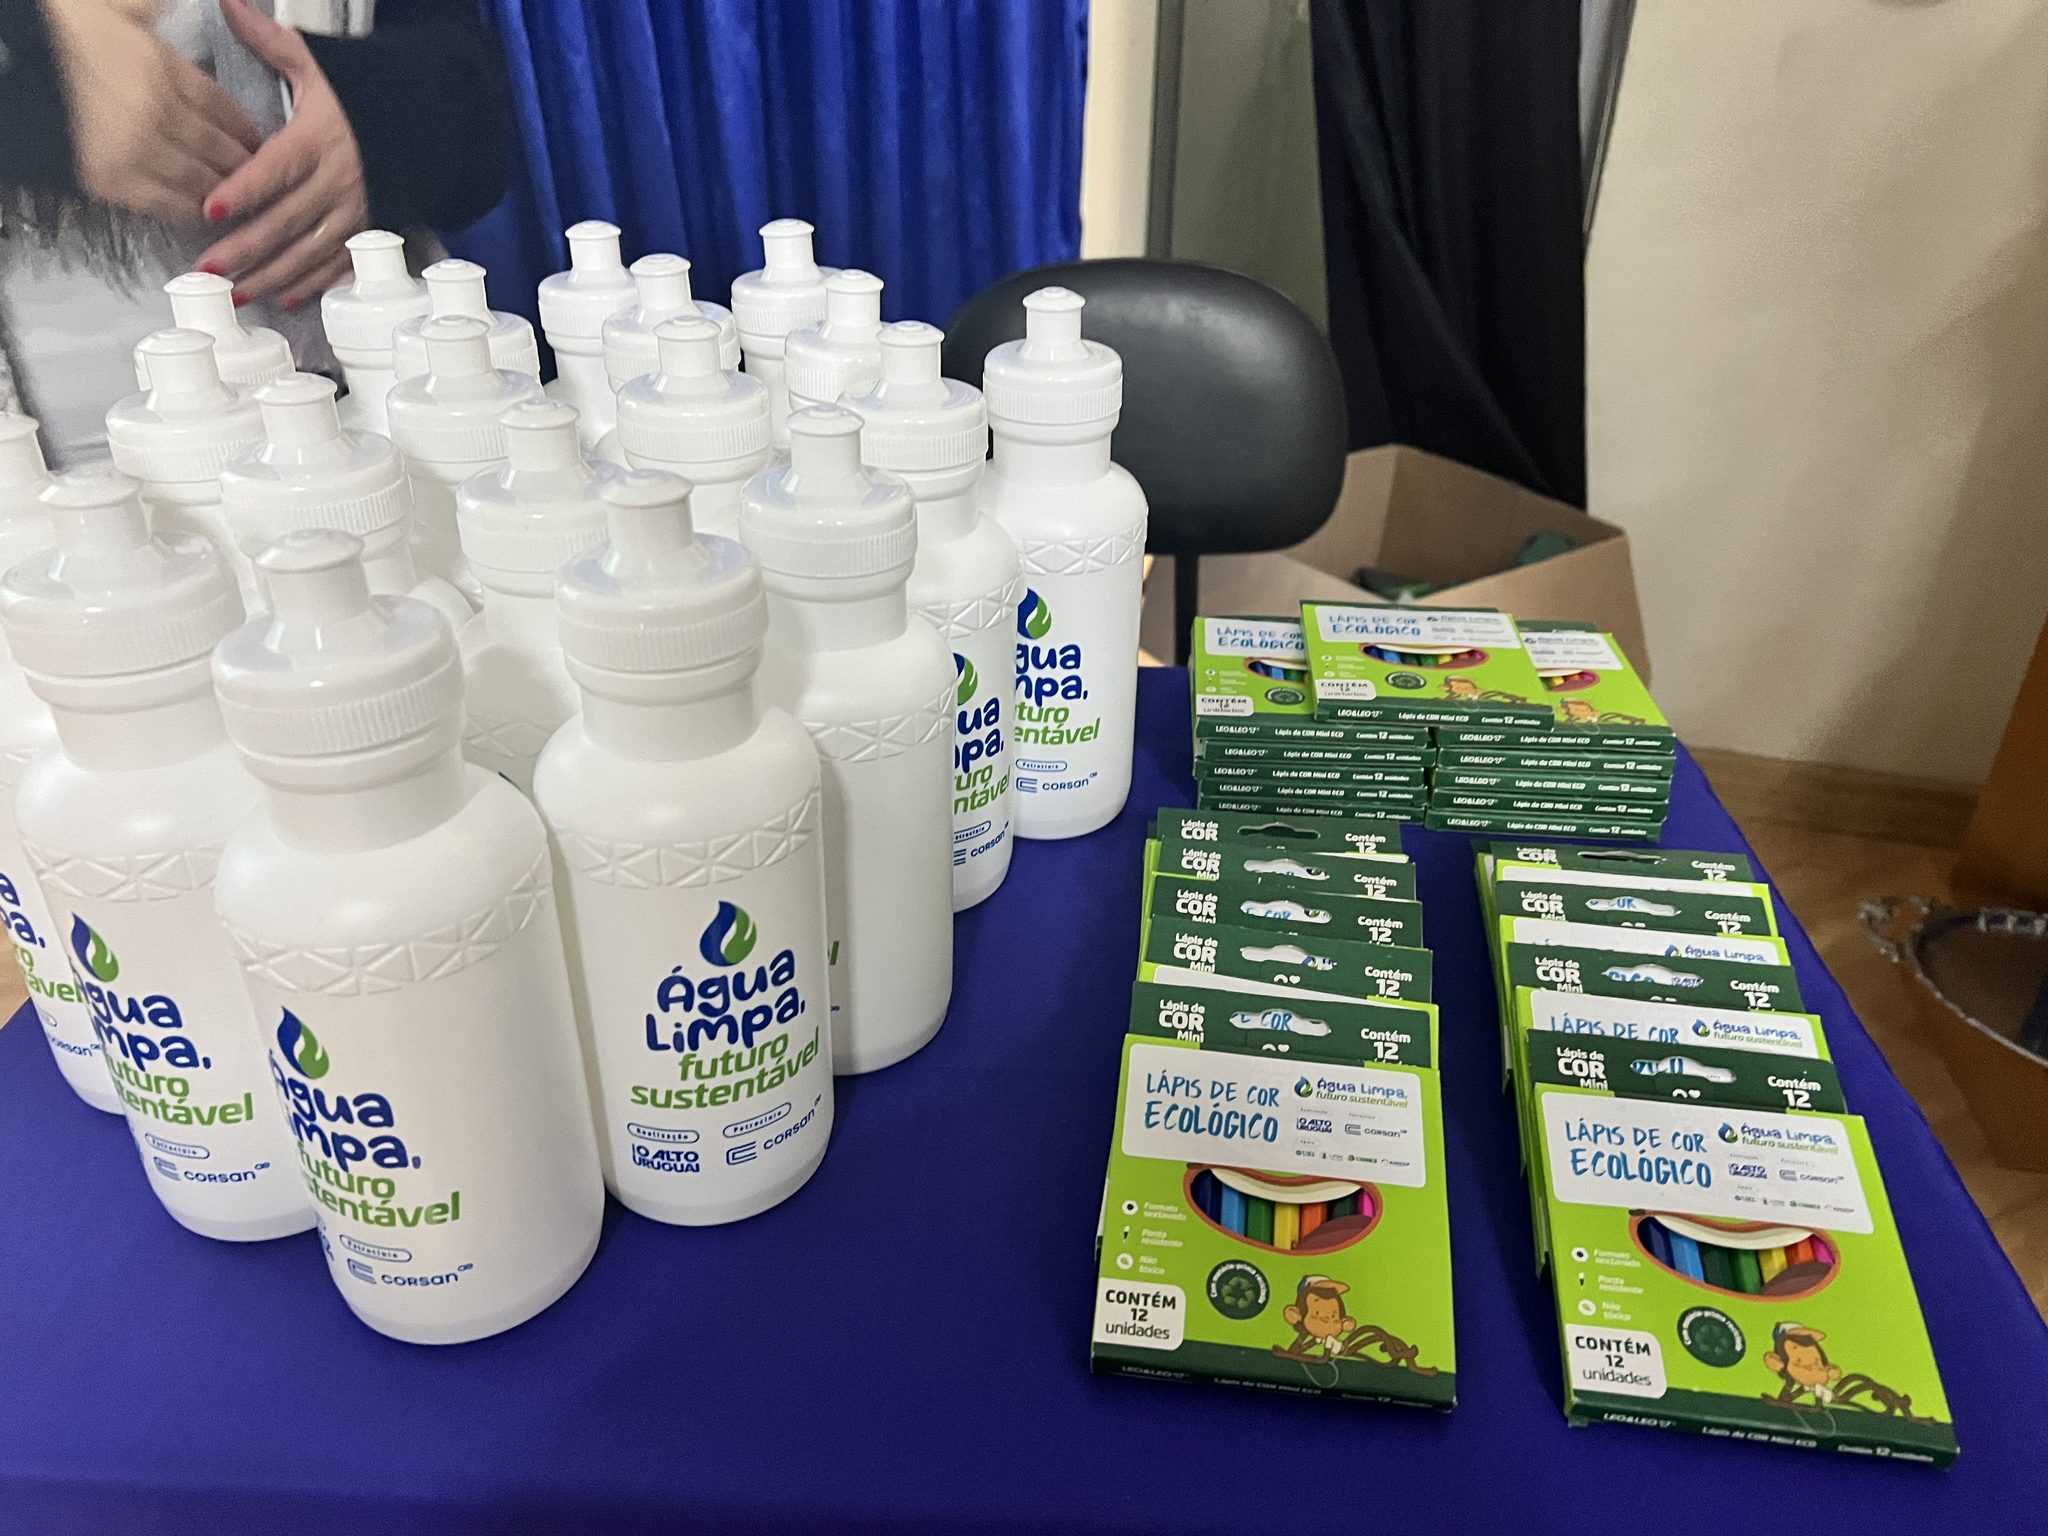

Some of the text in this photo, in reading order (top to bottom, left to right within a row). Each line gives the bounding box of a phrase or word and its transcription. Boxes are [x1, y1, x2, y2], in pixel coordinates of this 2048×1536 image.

[1016, 643, 1081, 675] gua
[957, 696, 1000, 735] ua
[1016, 701, 1070, 724] turo
[1014, 717, 1101, 746] entável
[955, 764, 993, 792] uro
[954, 764, 1010, 816] ntável
[1181, 819, 1218, 829] Lápis de
[1181, 827, 1218, 841] COR
[1345, 833, 1386, 843] Contém
[1183, 848, 1221, 860] Lápis de
[1356, 841, 1377, 854] 12
[1517, 851, 1558, 863] COR
[1181, 857, 1220, 875] COR
[1196, 870, 1219, 880] Mini
[1354, 874, 1397, 887] Contém
[1703, 869, 1727, 881] 12
[1177, 889, 1218, 902] Lápis de
[1365, 884, 1386, 898] 12
[1520, 891, 1563, 901] Lápis de
[1176, 899, 1216, 917] COR
[1522, 899, 1564, 914] COR
[1357, 916, 1404, 929] Contém
[1717, 920, 1742, 935] 12
[1176, 933, 1218, 947] Lápis de
[1369, 926, 1392, 943] 12
[1174, 943, 1216, 964] COR
[1190, 962, 1215, 974] Mini
[1535, 957, 1580, 969] Lápis de
[1364, 966, 1412, 982] Contém
[1536, 966, 1581, 984] COR
[657, 949, 795, 1018] Água
[1376, 979, 1400, 997] 12
[1557, 983, 1583, 994] Mini
[1730, 980, 1780, 994] Contém
[1159, 1000, 1205, 1013] Lápis de
[1744, 991, 1771, 1008] 12
[1159, 1010, 1204, 1031] COR
[1713, 1019, 1750, 1035] Água
[1177, 1030, 1204, 1043] Mini
[1361, 1028, 1411, 1044] Contém
[1551, 1013, 1680, 1045] LÁPIS DE COR
[678, 1033, 789, 1081] futuro
[1373, 1041, 1399, 1060] 12
[1557, 1046, 1604, 1061] Lápis de
[630, 1025, 820, 1109] sustentável
[1558, 1058, 1606, 1080] COR
[110, 1058, 189, 1098] uturo
[1317, 1077, 1356, 1093] Água
[1580, 1078, 1608, 1090] Mini
[1767, 1076, 1821, 1092] Contém
[1146, 1070, 1280, 1107] LÁPIS DE COR
[1316, 1090, 1409, 1109] futuro sustentável
[1783, 1089, 1811, 1108] 12
[1144, 1101, 1279, 1143] ECOLÓGICO
[1566, 1118, 1707, 1153] LÁPIS DE COR
[1741, 1123, 1782, 1139] Água
[1742, 1136, 1776, 1148] futuro
[652, 1149, 699, 1162] ALTO
[299, 1143, 396, 1199] uturo
[1570, 1148, 1713, 1189] ECOLÓGICO
[1105, 1290, 1176, 1310] CONTÉM
[1131, 1308, 1148, 1322] 12
[1105, 1322, 1170, 1340] unidades
[1575, 1332, 1651, 1357] CONTÉM
[1605, 1354, 1625, 1369] 12
[1582, 1366, 1652, 1387] unidades
